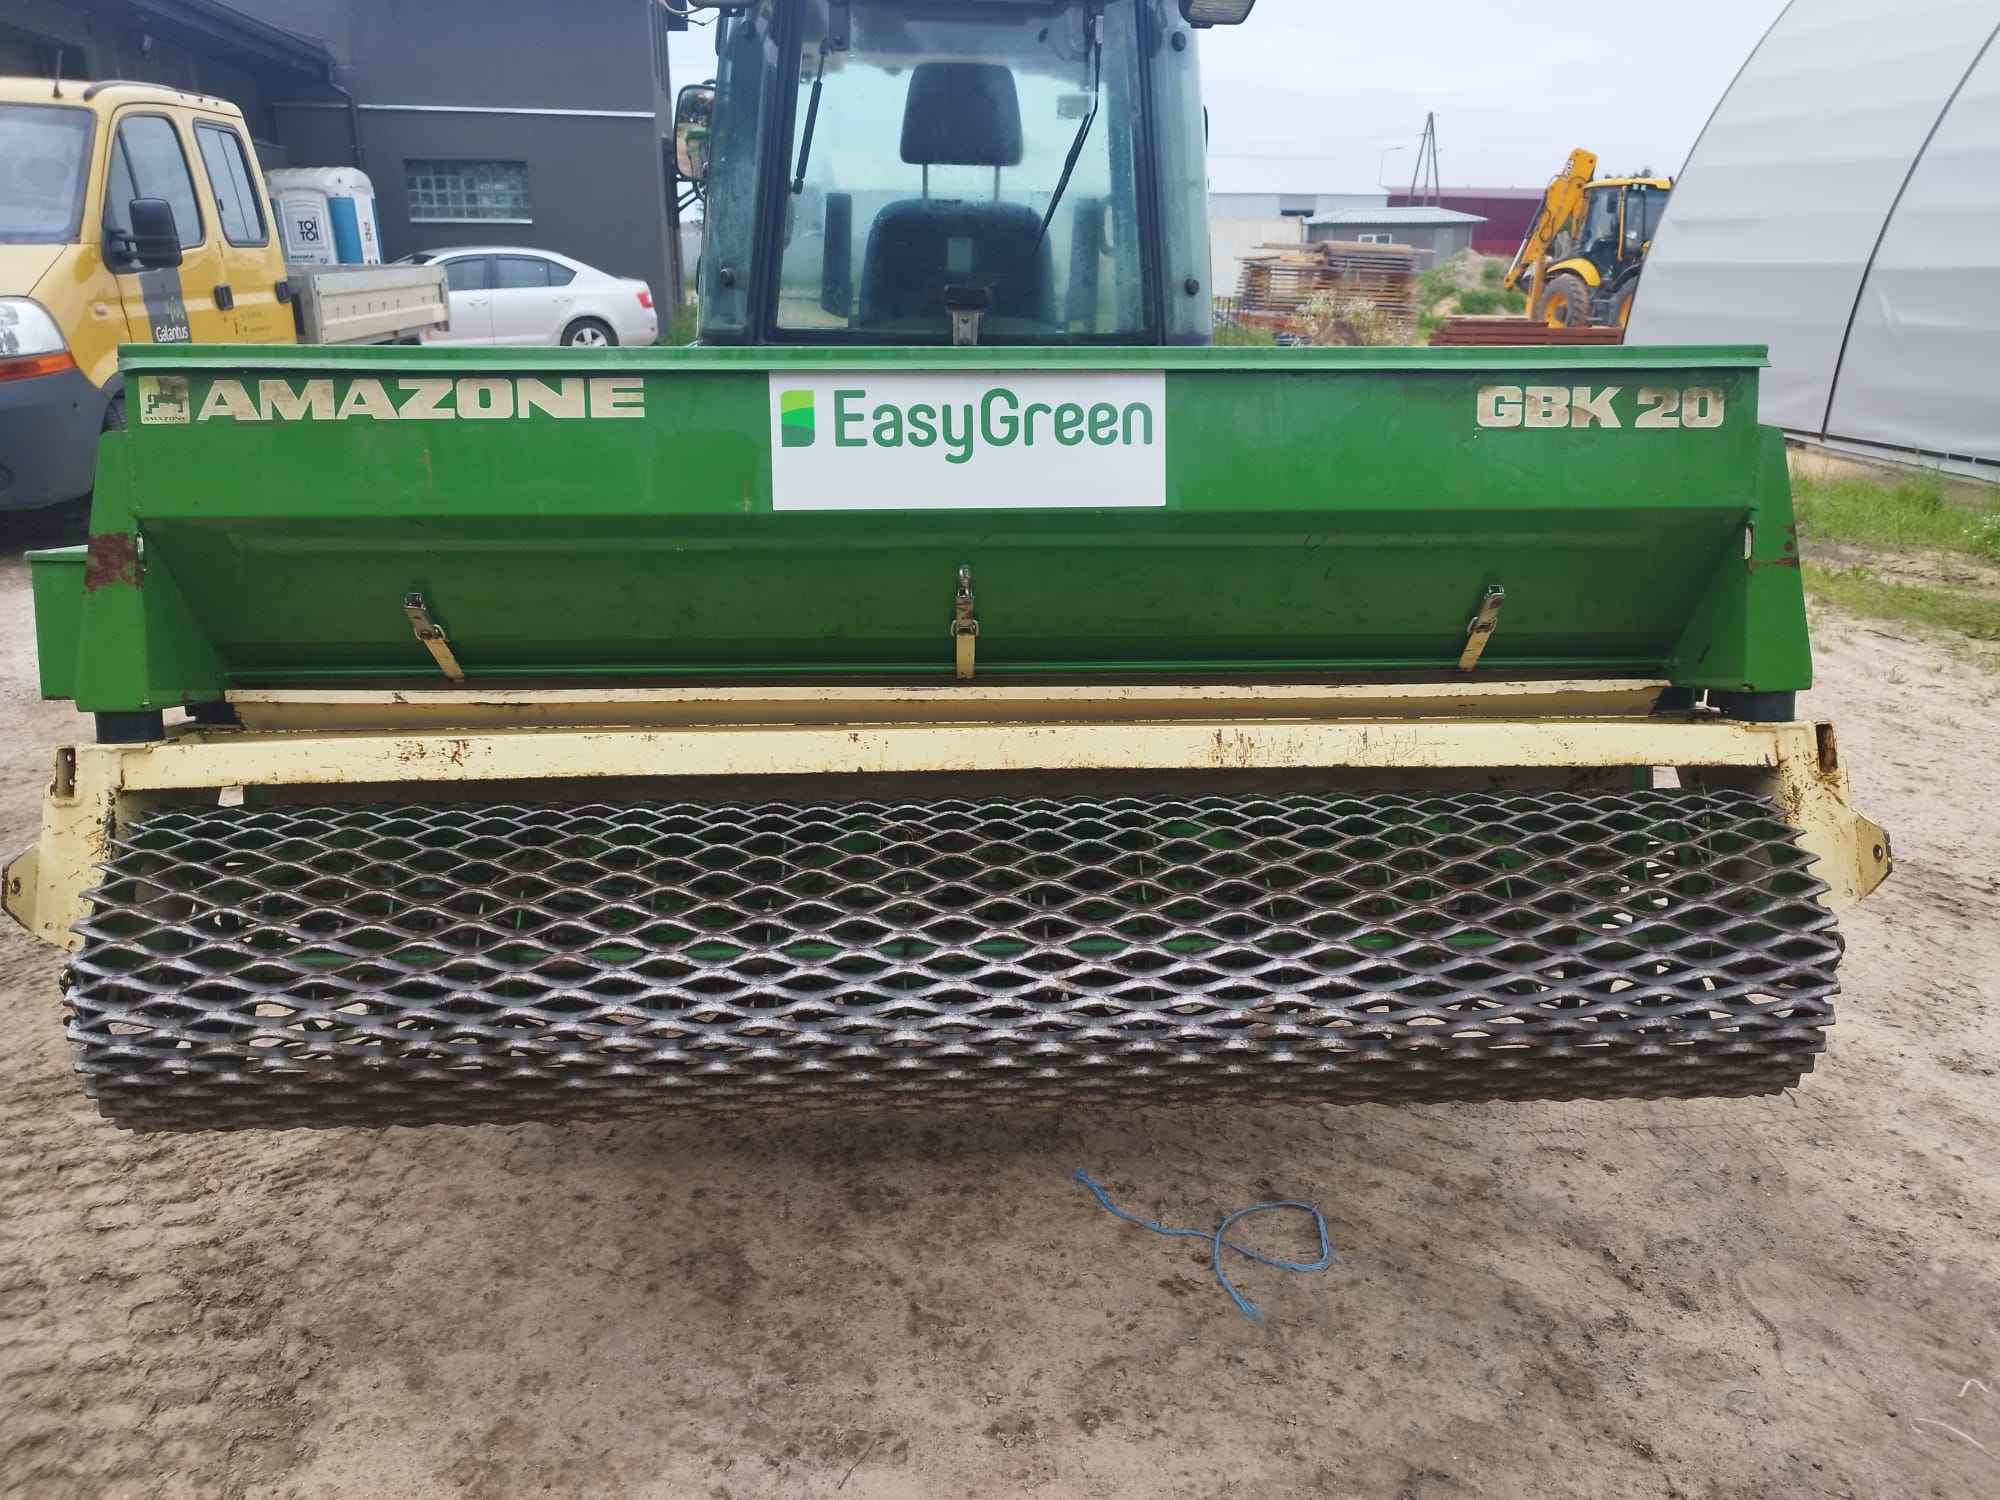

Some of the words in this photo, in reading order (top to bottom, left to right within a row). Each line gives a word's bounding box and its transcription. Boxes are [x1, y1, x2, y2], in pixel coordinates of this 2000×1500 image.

[299, 231, 320, 241] TOI
[156, 325, 189, 342] Galantus
[197, 378, 645, 421] AMAZONE
[1476, 386, 1623, 427] GBK
[1635, 386, 1725, 428] 20
[834, 388, 1153, 464] EasyGreen
